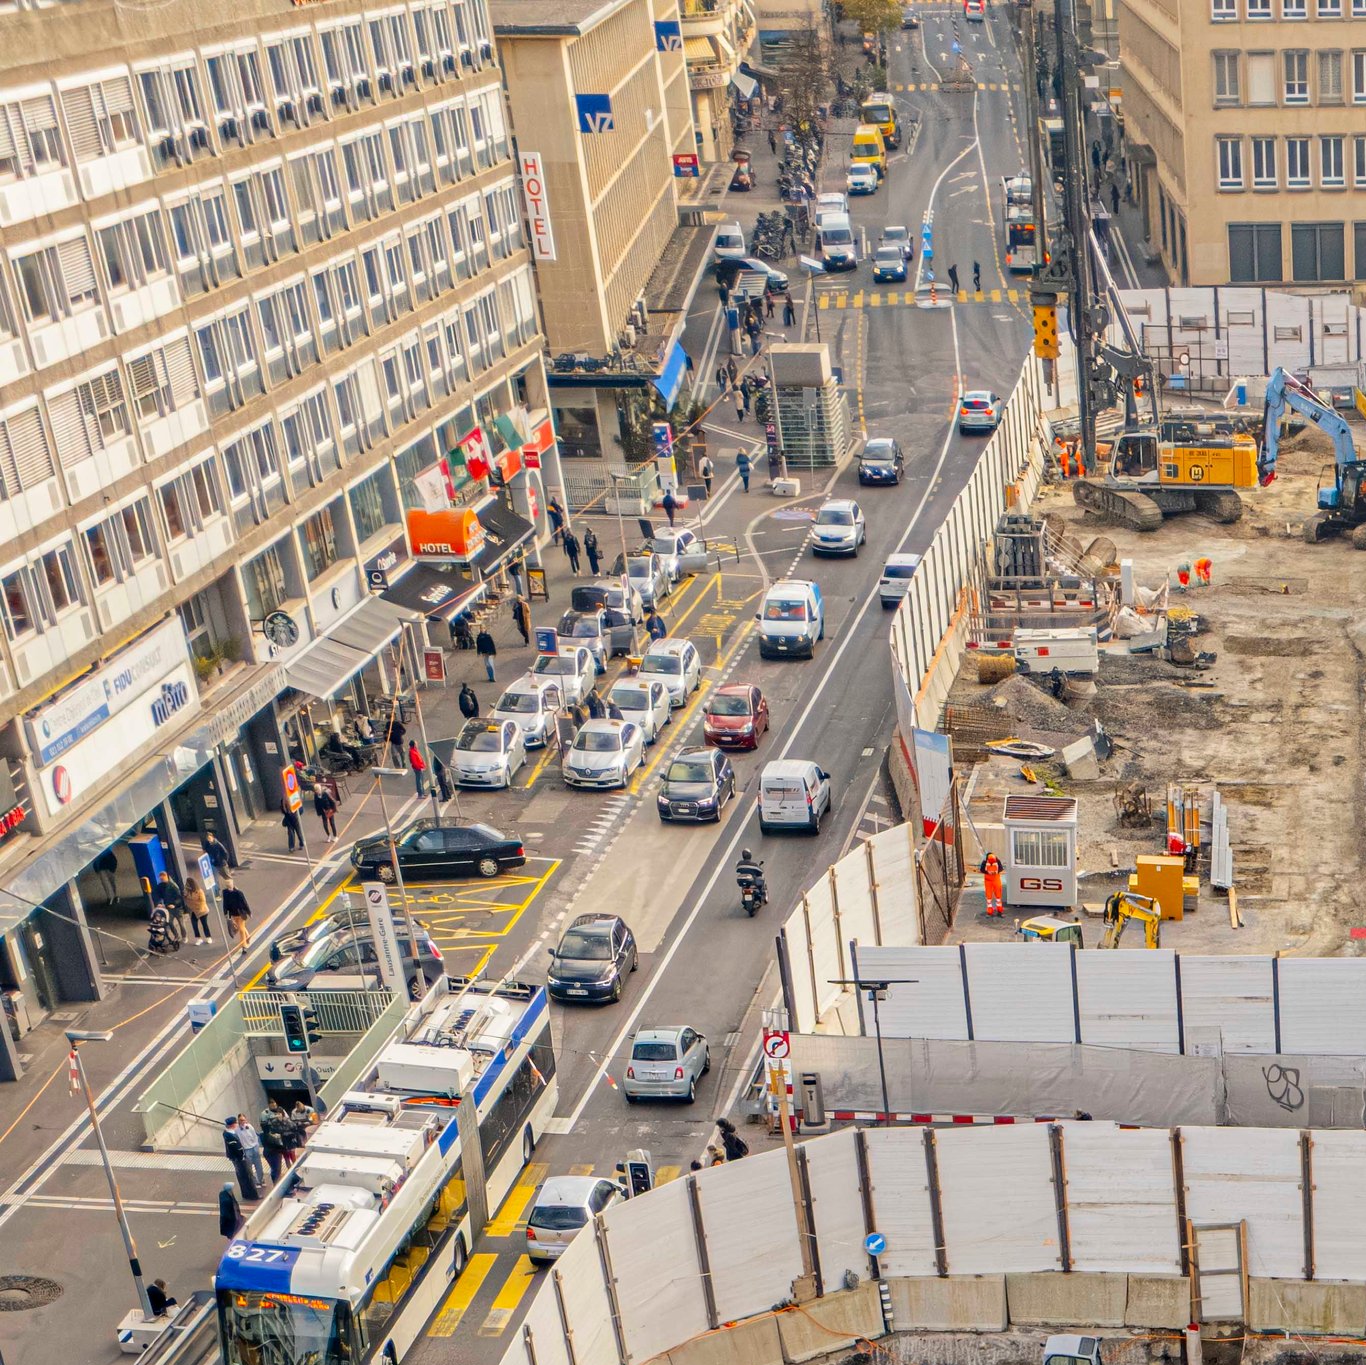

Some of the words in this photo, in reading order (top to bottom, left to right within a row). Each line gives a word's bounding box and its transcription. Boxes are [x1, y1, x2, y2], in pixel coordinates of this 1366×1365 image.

[661, 35, 683, 52] VZ
[585, 112, 615, 133] VZ
[523, 158, 550, 256] HOTEL
[419, 543, 456, 554] HOTEL
[151, 680, 188, 727] métro
[1020, 877, 1063, 891] GS
[377, 917, 395, 977] Lausanne-Gare
[316, 1065, 336, 1075] Ouch
[227, 1244, 283, 1262] 827
